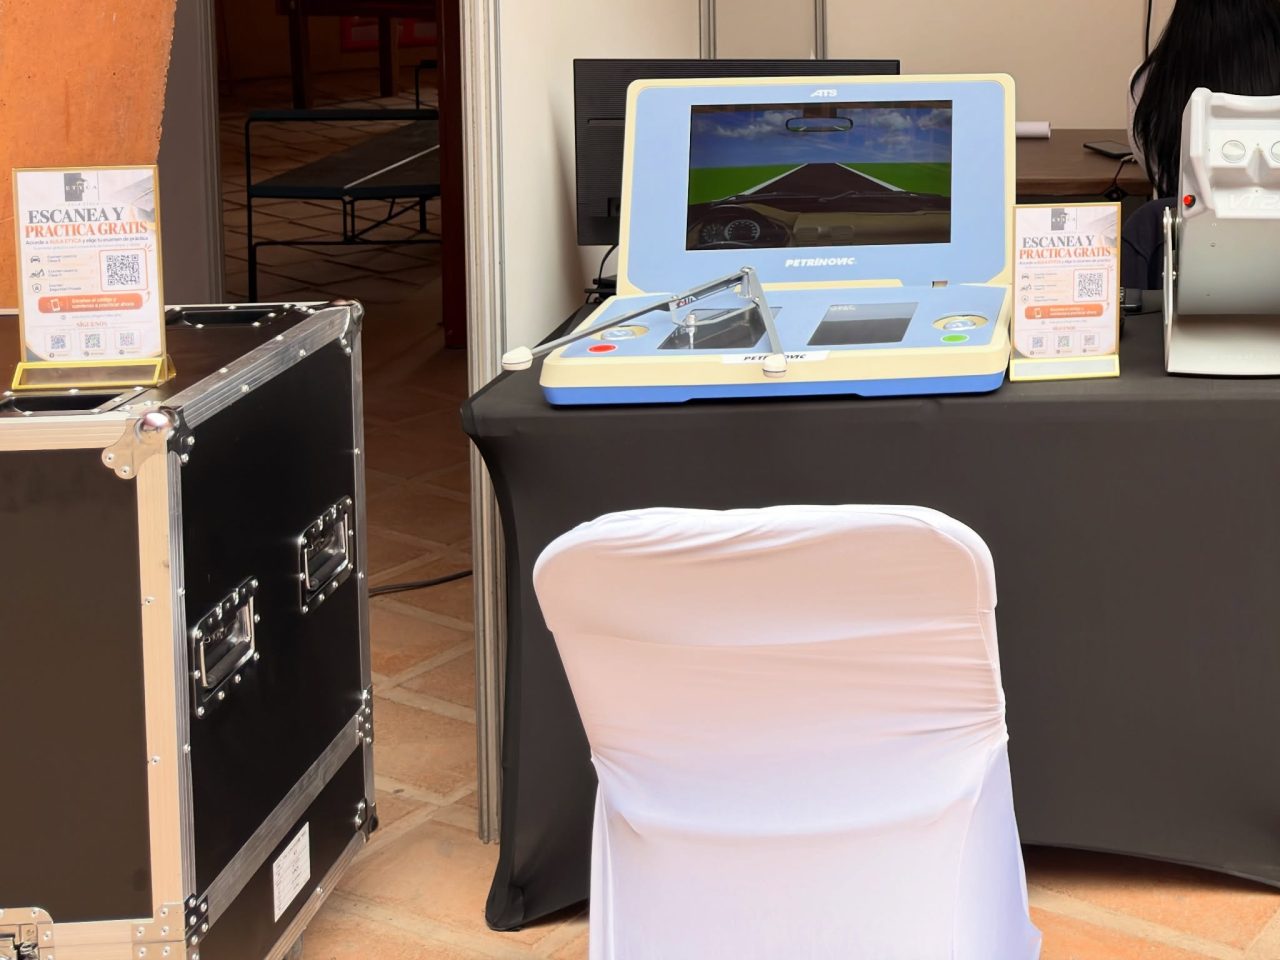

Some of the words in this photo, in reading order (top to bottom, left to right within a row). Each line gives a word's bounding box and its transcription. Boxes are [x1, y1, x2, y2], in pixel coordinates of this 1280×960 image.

[27, 208, 109, 224] ESCANEA
[112, 207, 124, 221] Y
[25, 222, 96, 238] PRACTICA
[98, 221, 147, 236] GRATIS
[1023, 235, 1083, 248] ESCANEA
[1085, 235, 1095, 246] Y
[1019, 247, 1072, 259] PRACTICA
[1074, 246, 1111, 257] GRATIS
